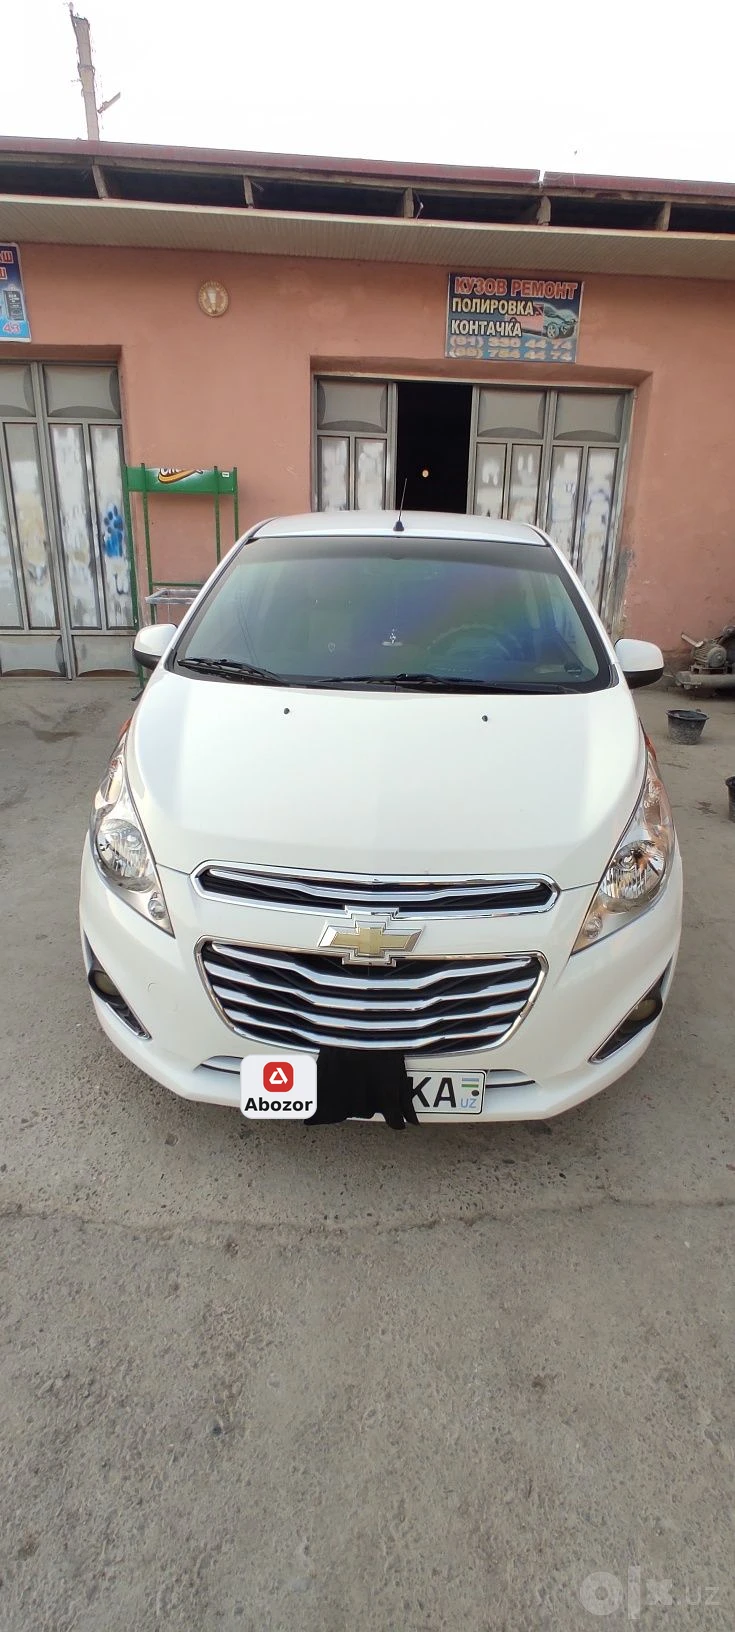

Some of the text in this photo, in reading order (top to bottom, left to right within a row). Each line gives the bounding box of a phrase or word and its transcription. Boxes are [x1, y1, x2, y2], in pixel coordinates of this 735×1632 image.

[454, 276, 578, 300] КУЗОВ РЕМОНТ
[452, 297, 534, 316] ПОЛИРОВКА
[451, 319, 522, 337] КОНТАЧКА
[460, 1097, 477, 1109] UZ
